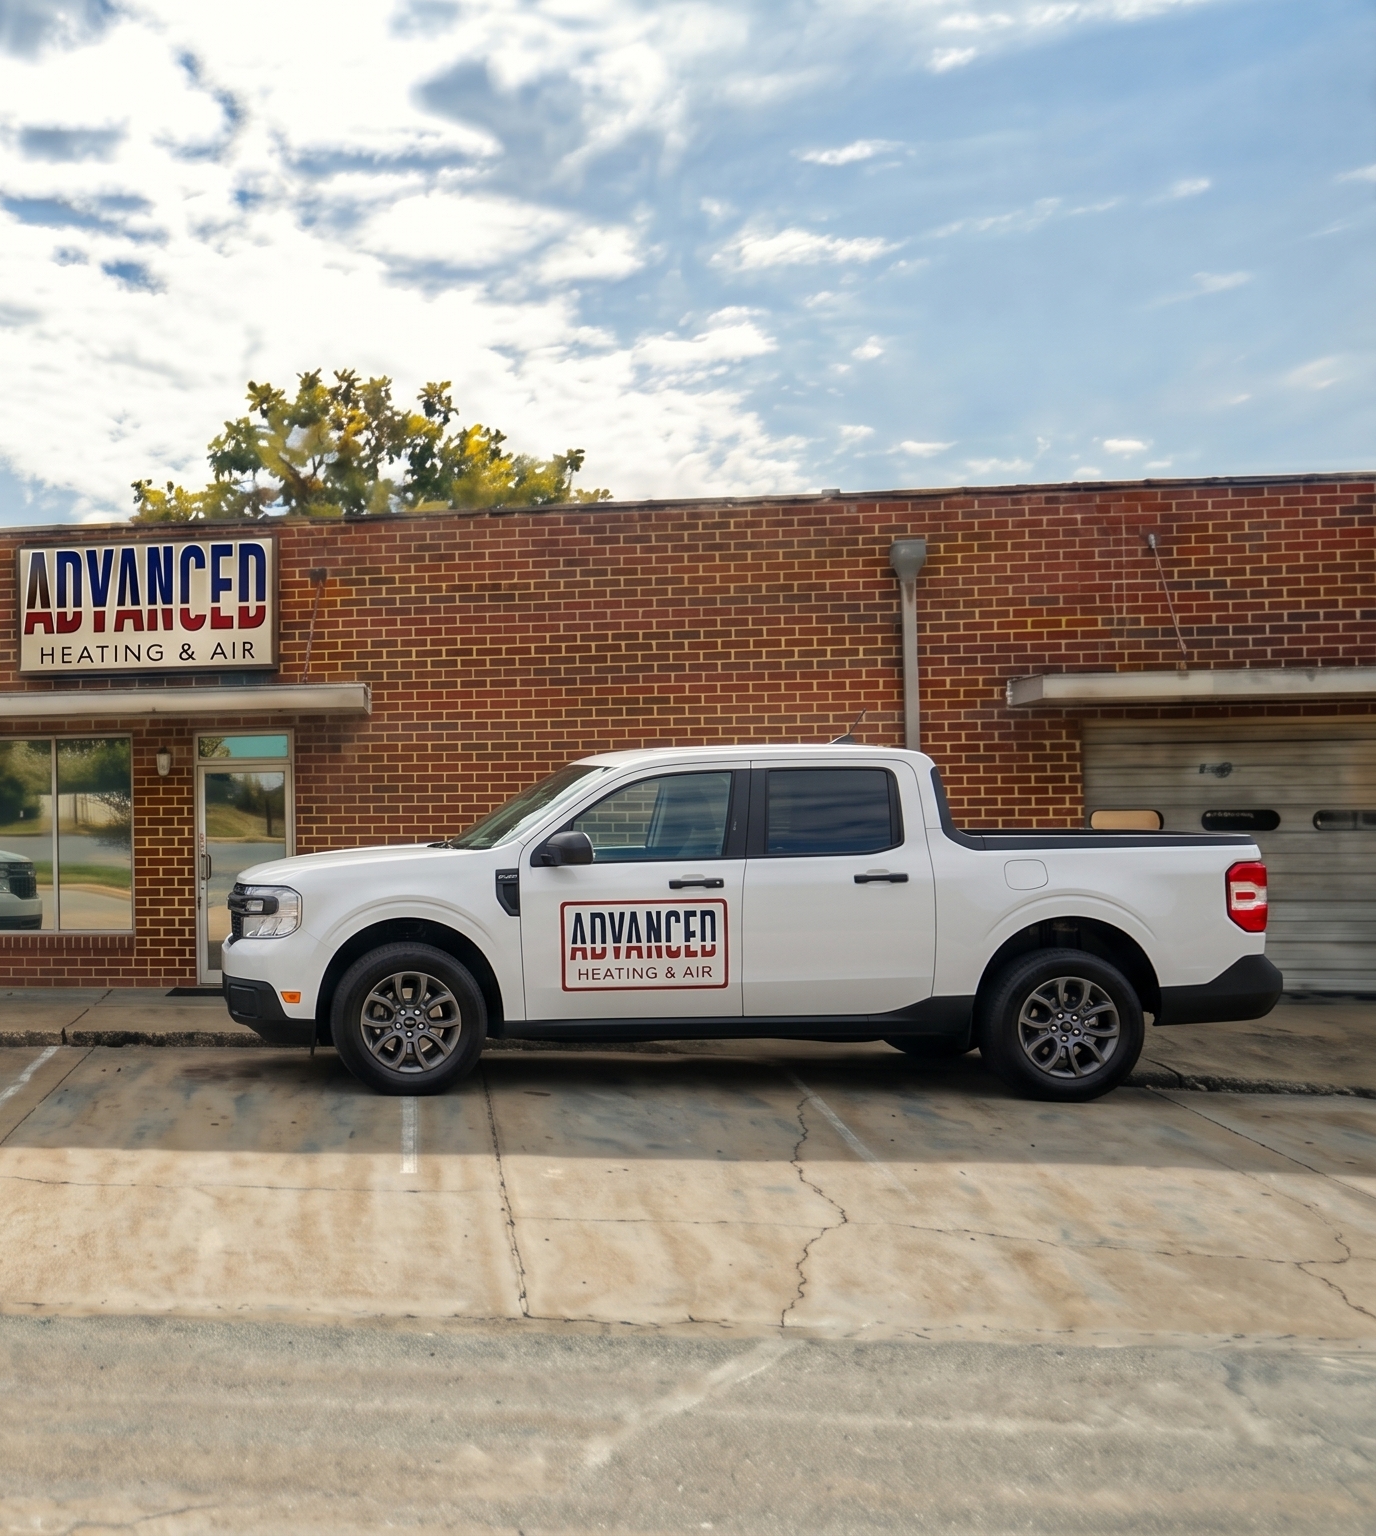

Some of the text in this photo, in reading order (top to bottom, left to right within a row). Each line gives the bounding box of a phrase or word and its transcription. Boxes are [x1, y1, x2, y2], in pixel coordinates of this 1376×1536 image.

[24, 543, 266, 634] ADVANCED
[40, 641, 255, 664] HEATING & AIR
[570, 910, 716, 960] ADVANCED
[578, 966, 713, 980] HEATING & AIR
